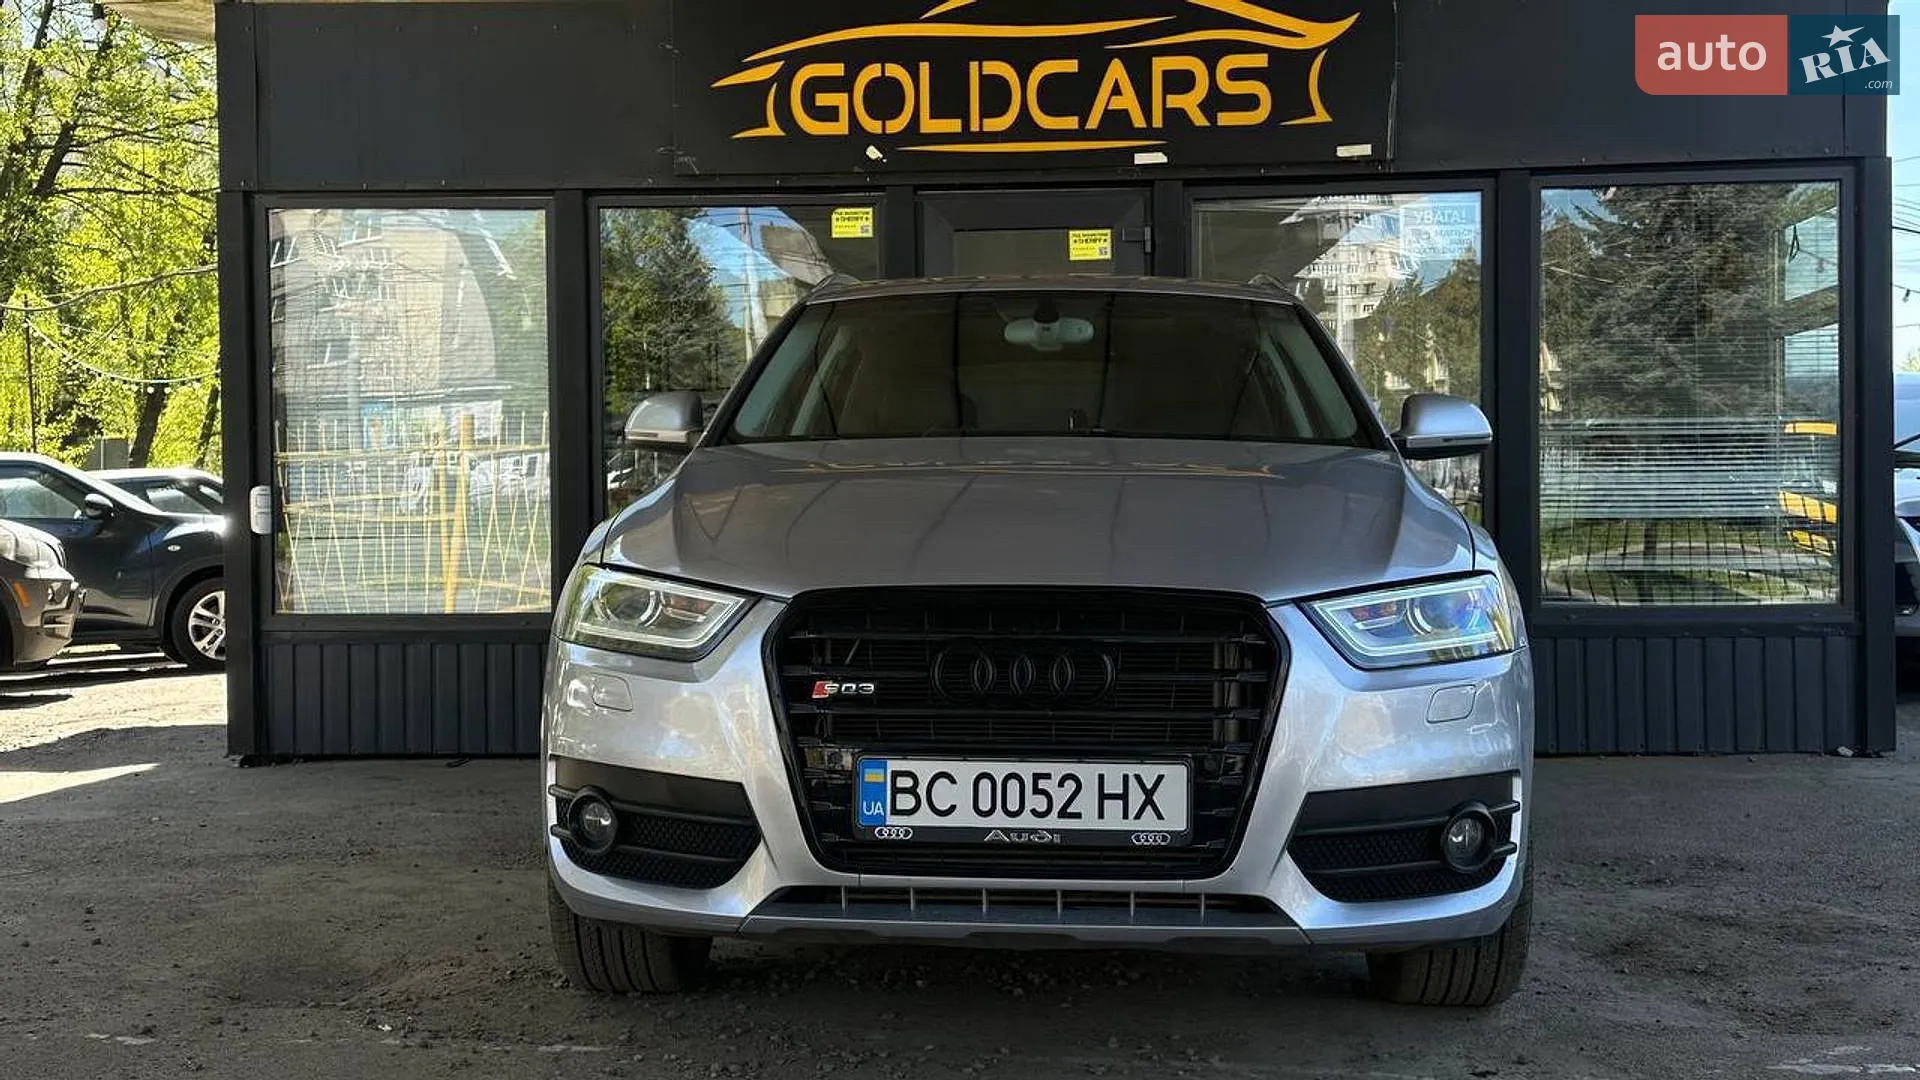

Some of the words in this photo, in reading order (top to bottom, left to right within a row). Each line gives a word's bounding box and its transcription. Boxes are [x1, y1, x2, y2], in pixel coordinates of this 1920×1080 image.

[790, 53, 1272, 135] GOLDCARS
[862, 800, 885, 817] UA
[889, 769, 958, 818] BC
[972, 772, 1083, 820] 0052
[1097, 773, 1165, 821] HX
